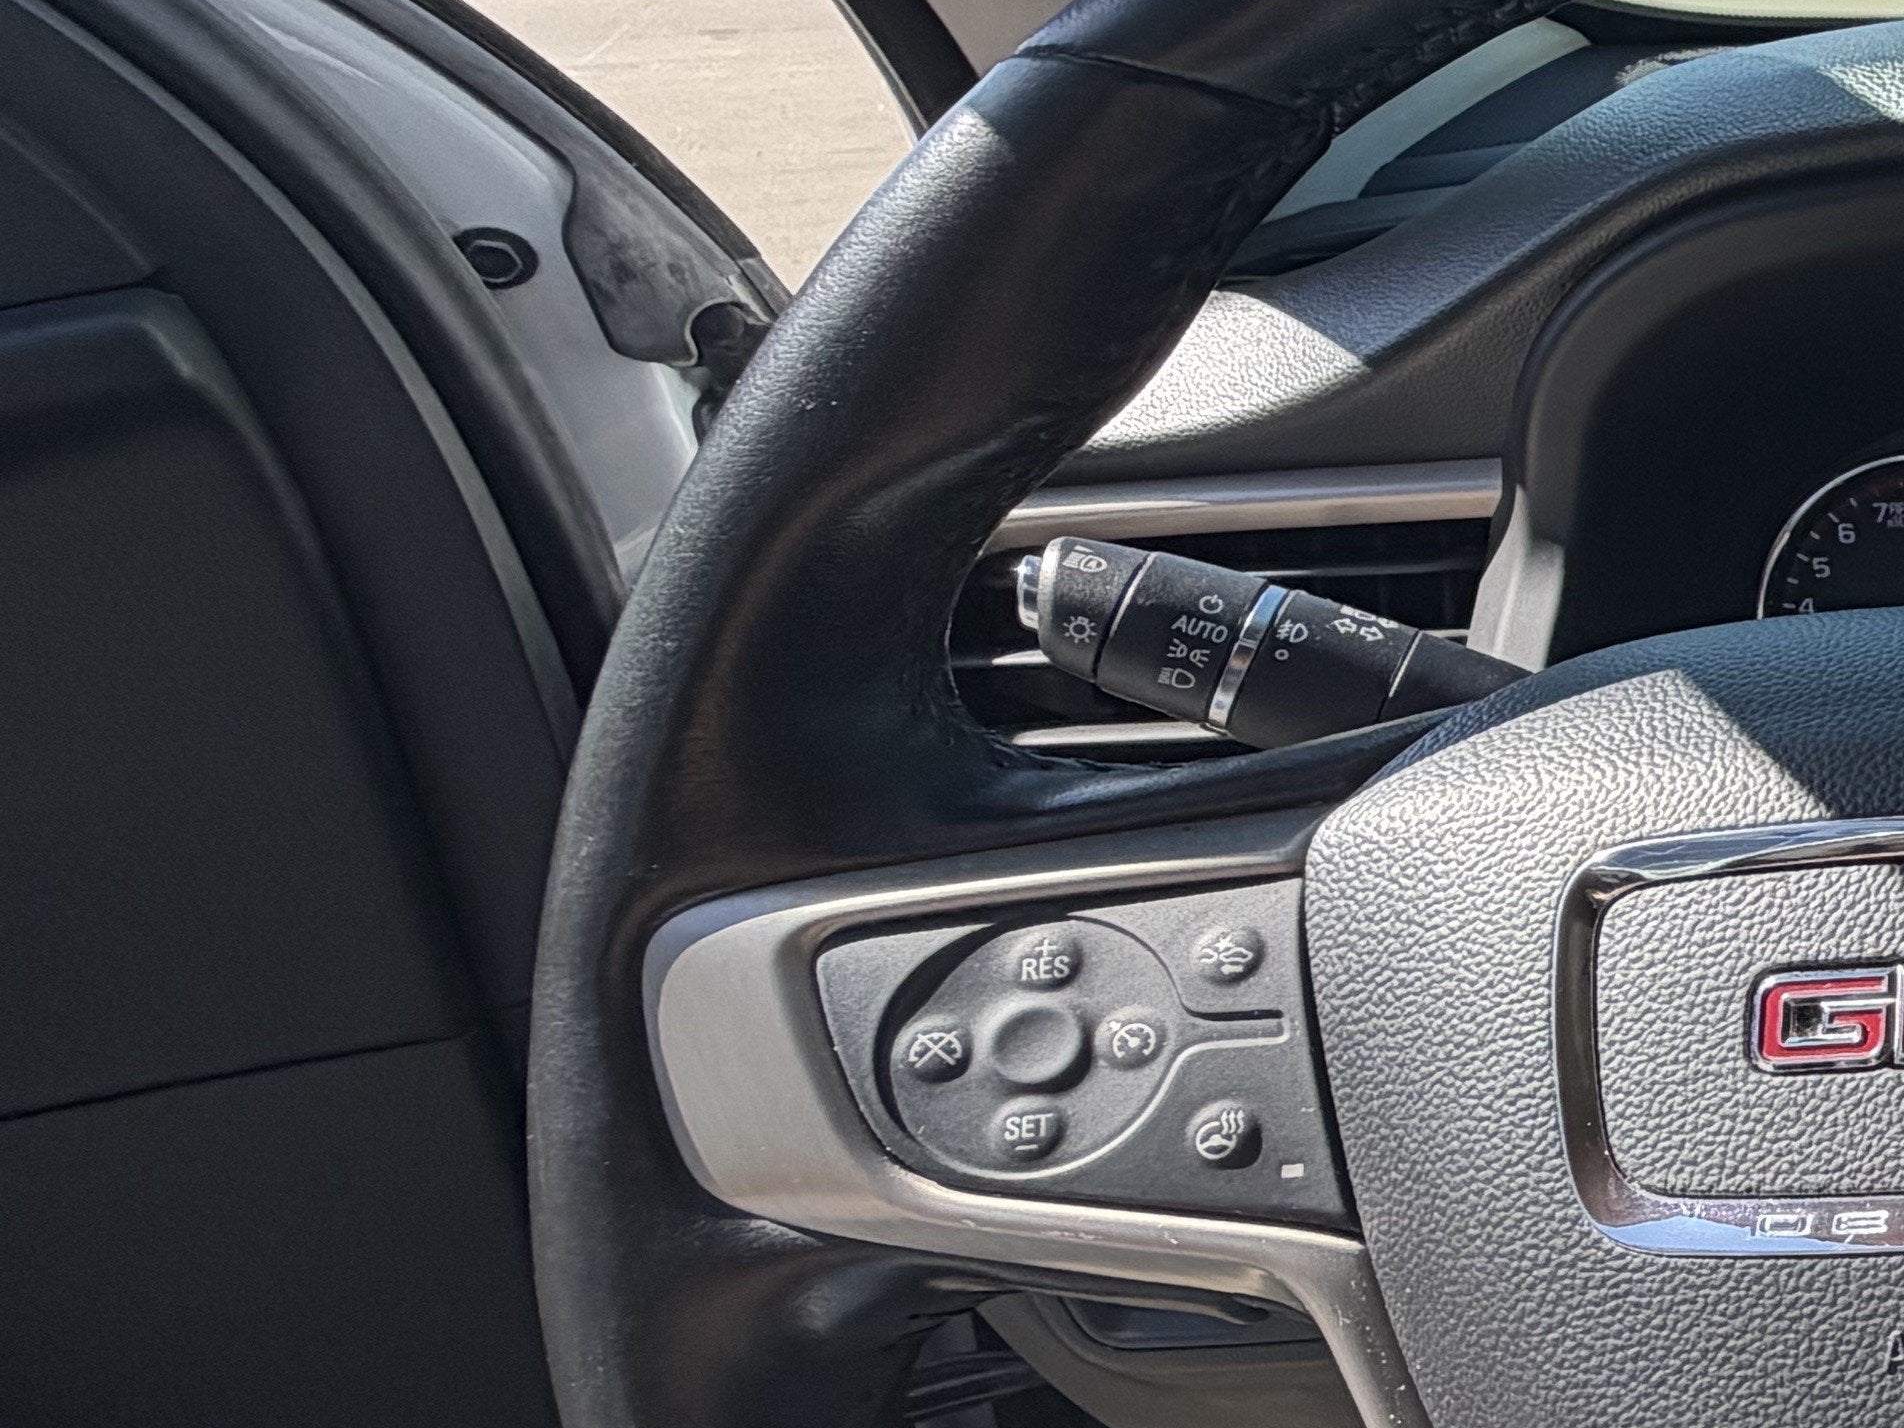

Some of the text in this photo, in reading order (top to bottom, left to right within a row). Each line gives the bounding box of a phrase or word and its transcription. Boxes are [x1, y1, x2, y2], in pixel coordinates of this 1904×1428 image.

[1871, 501, 1889, 524] 7
[1836, 523, 1857, 545] 6
[1811, 556, 1832, 579] 5
[1172, 612, 1229, 644] AUTO
[1020, 954, 1071, 981] RES
[1004, 1112, 1055, 1139] SET
